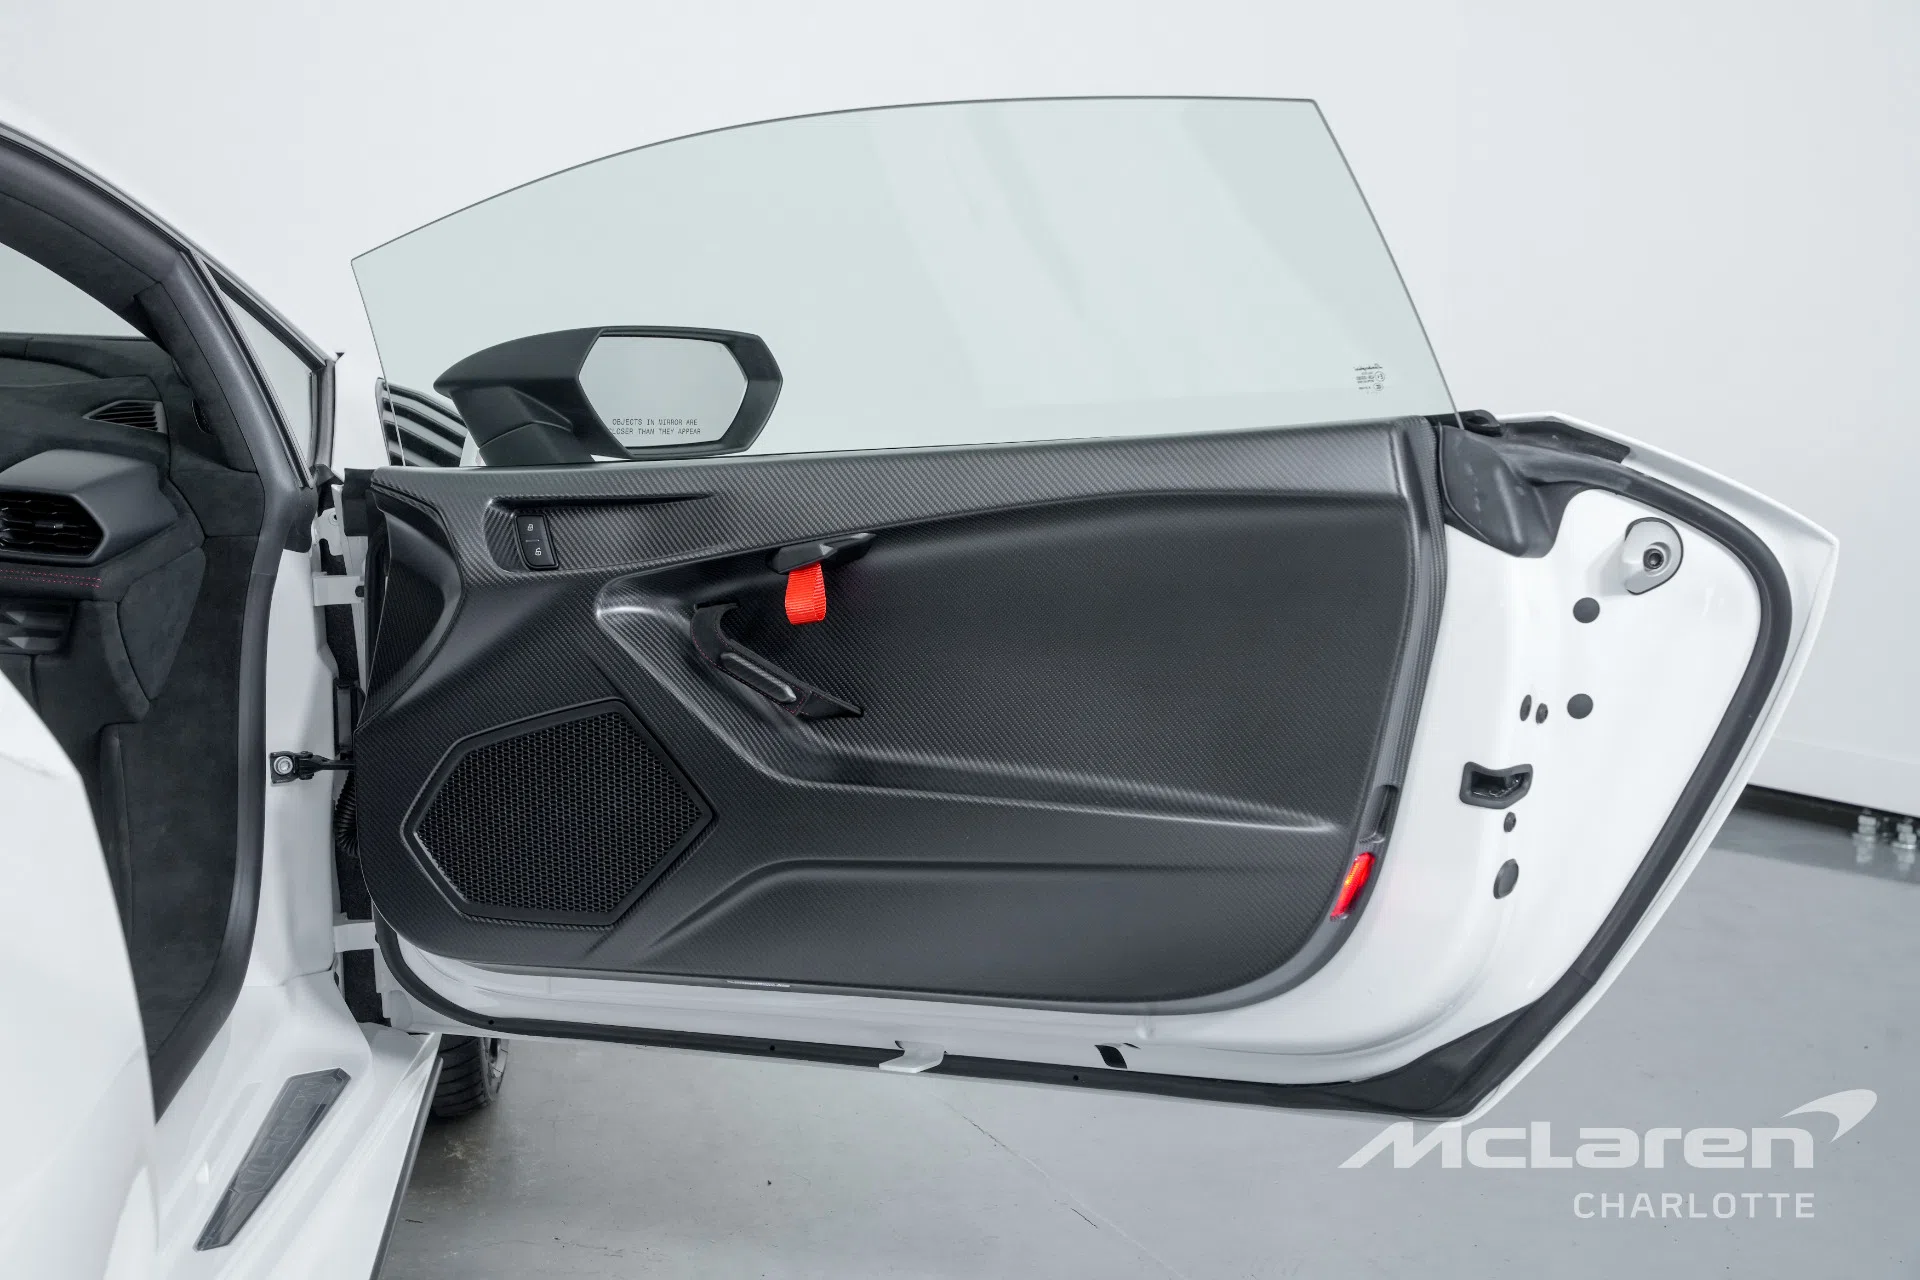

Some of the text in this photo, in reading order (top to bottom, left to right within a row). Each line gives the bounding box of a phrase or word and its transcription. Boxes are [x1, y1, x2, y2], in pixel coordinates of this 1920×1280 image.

[612, 418, 698, 426] OBJECTS IN MIRROR ARE
[638, 427, 655, 435] THAN
[658, 427, 675, 435] THEY
[677, 427, 701, 435] APPEAR
